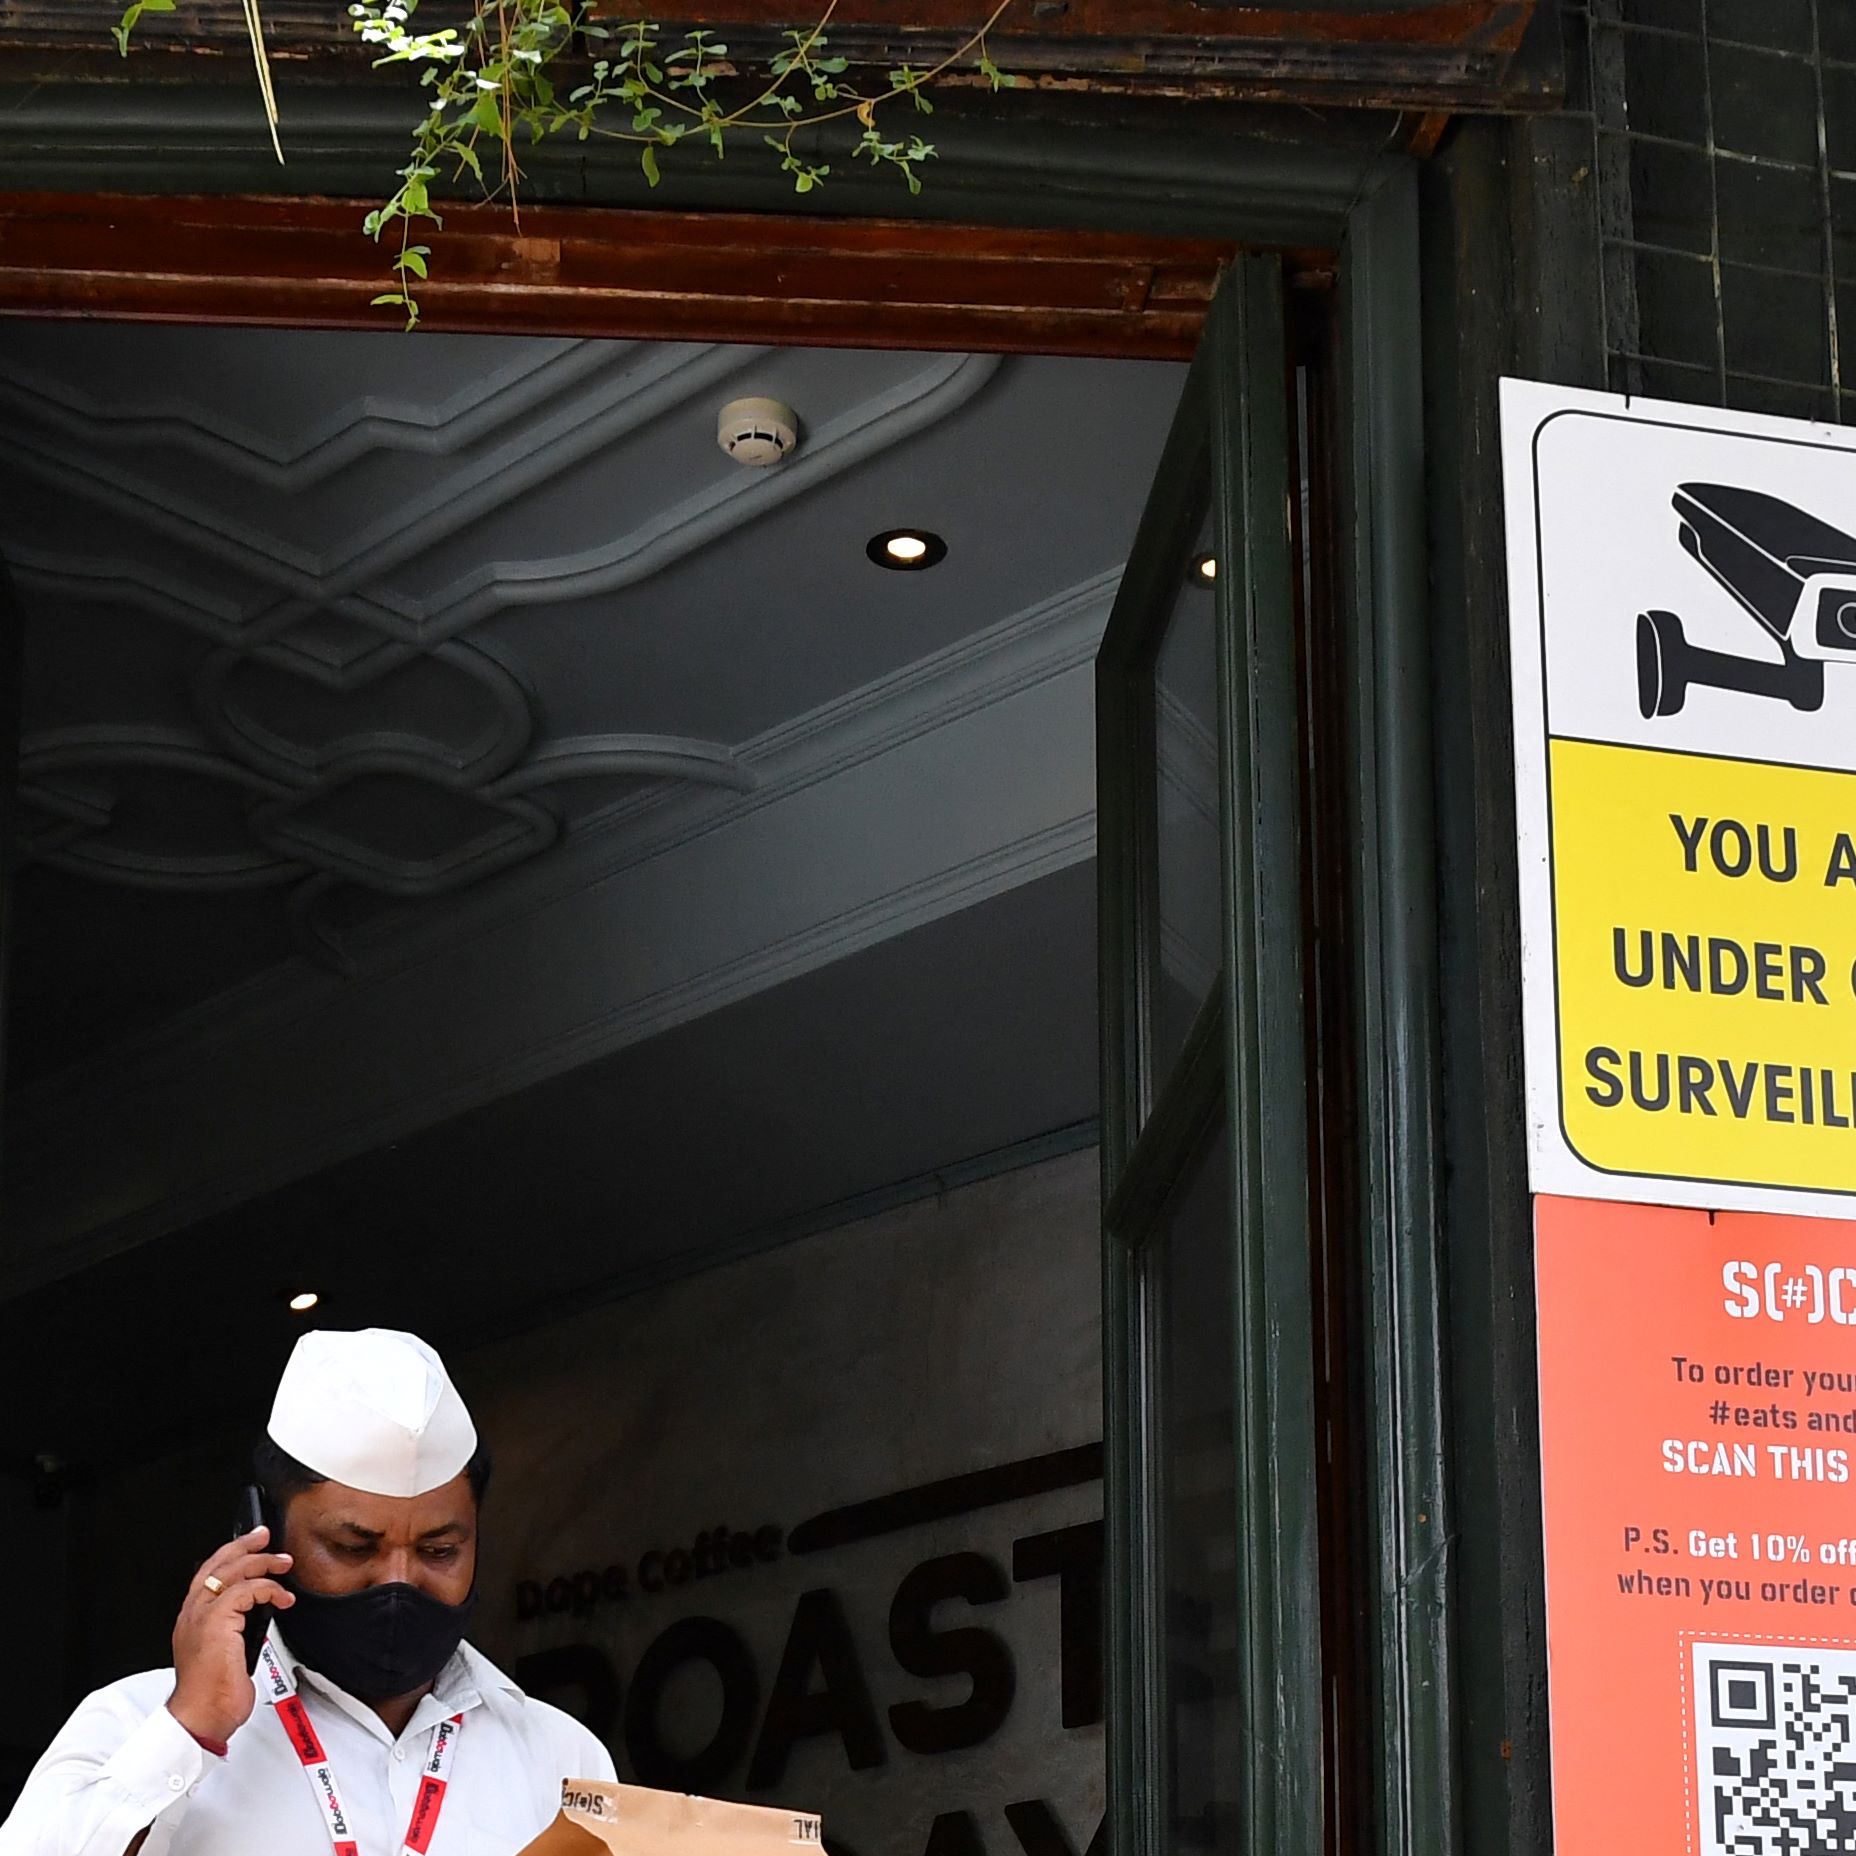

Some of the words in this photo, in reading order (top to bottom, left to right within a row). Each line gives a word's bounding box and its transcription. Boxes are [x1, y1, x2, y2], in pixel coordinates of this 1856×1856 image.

[1669, 814, 1797, 883] YOU
[1612, 928, 1830, 1005] UNDER
[1671, 1357, 1704, 1384] To
[1714, 1362, 1793, 1389] order
[1709, 1401, 1797, 1431] #eats
[1662, 1440, 1756, 1479] SCAN
[1767, 1445, 1848, 1484] THIS
[1624, 1527, 1679, 1556] P.S.
[1688, 1530, 1738, 1560] Get
[1752, 1533, 1811, 1564] 10%
[1617, 1570, 1690, 1598] when
[1700, 1578, 1751, 1602] you
[1761, 1578, 1840, 1606] order
